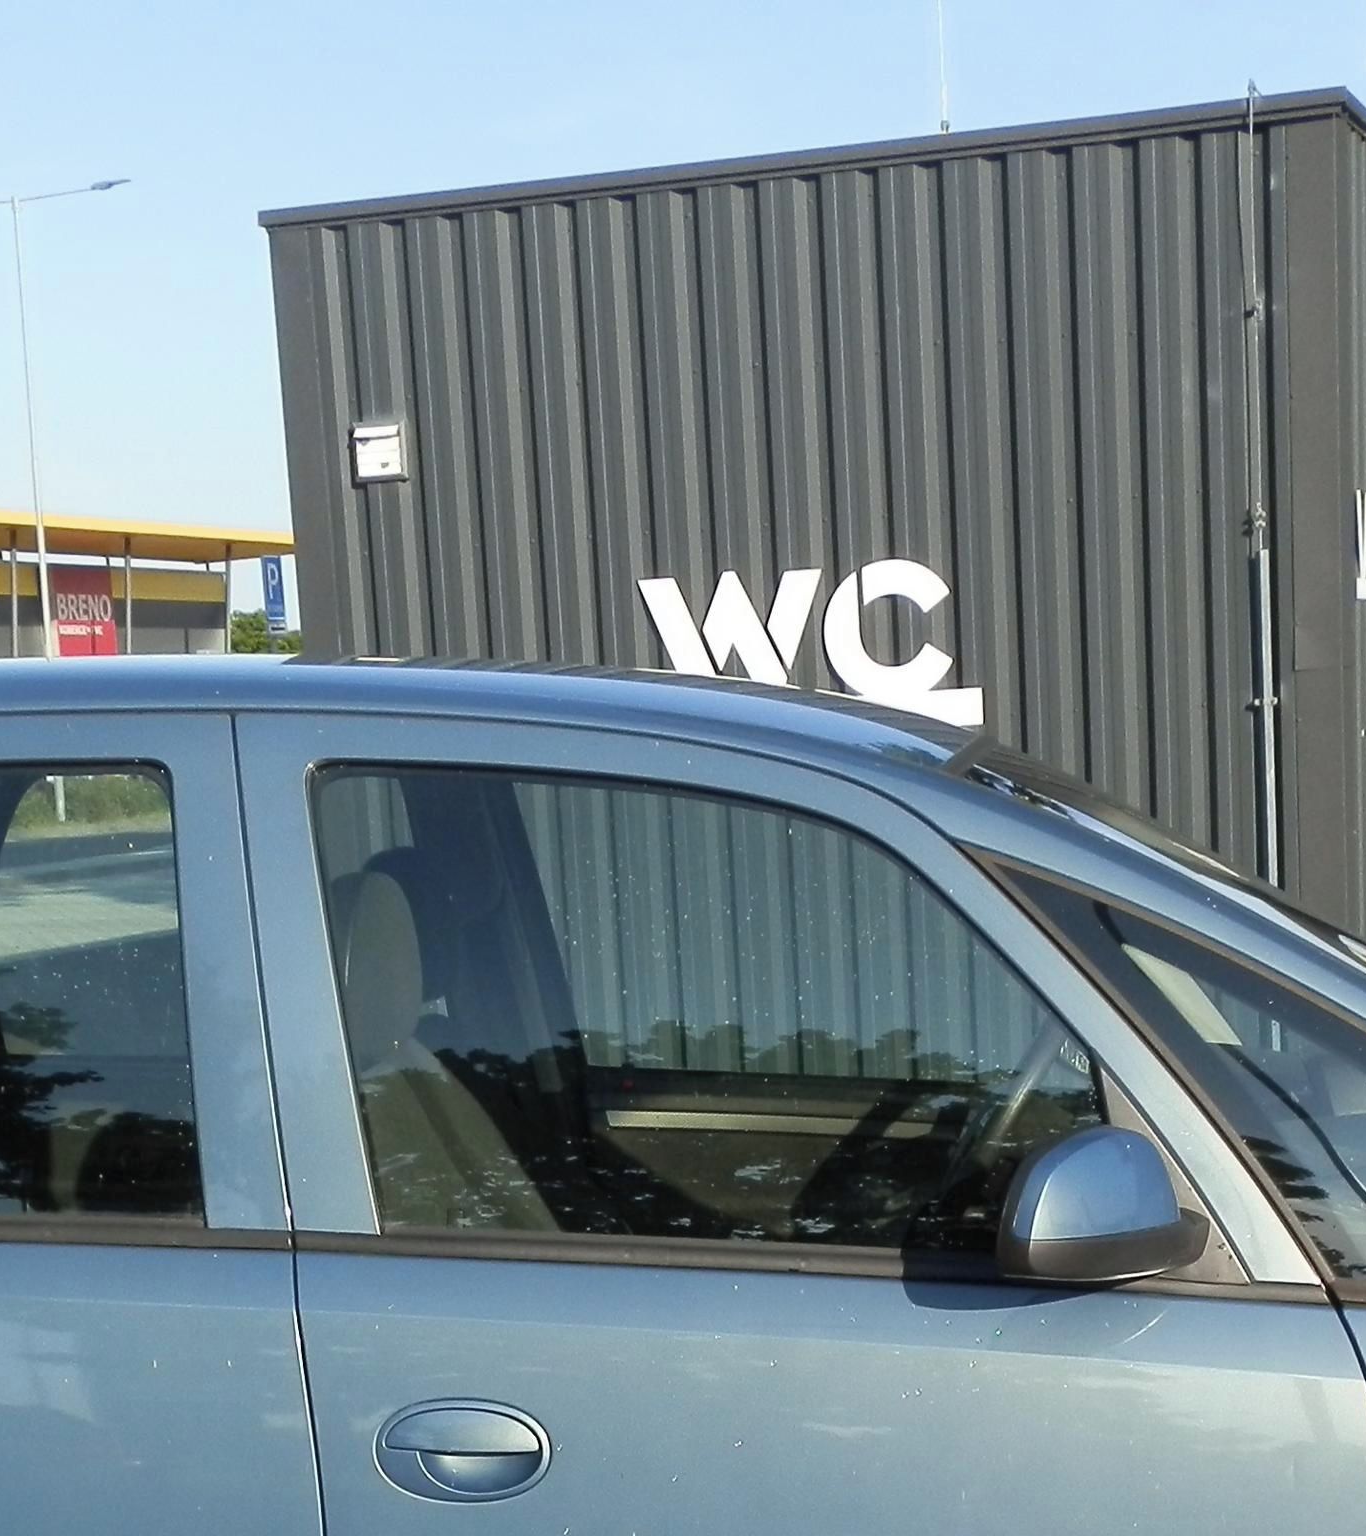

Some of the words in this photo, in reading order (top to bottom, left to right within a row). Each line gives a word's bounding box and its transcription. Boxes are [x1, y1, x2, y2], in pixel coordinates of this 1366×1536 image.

[267, 563, 279, 599] P
[56, 593, 112, 622] BRENO
[637, 557, 955, 698] WC
